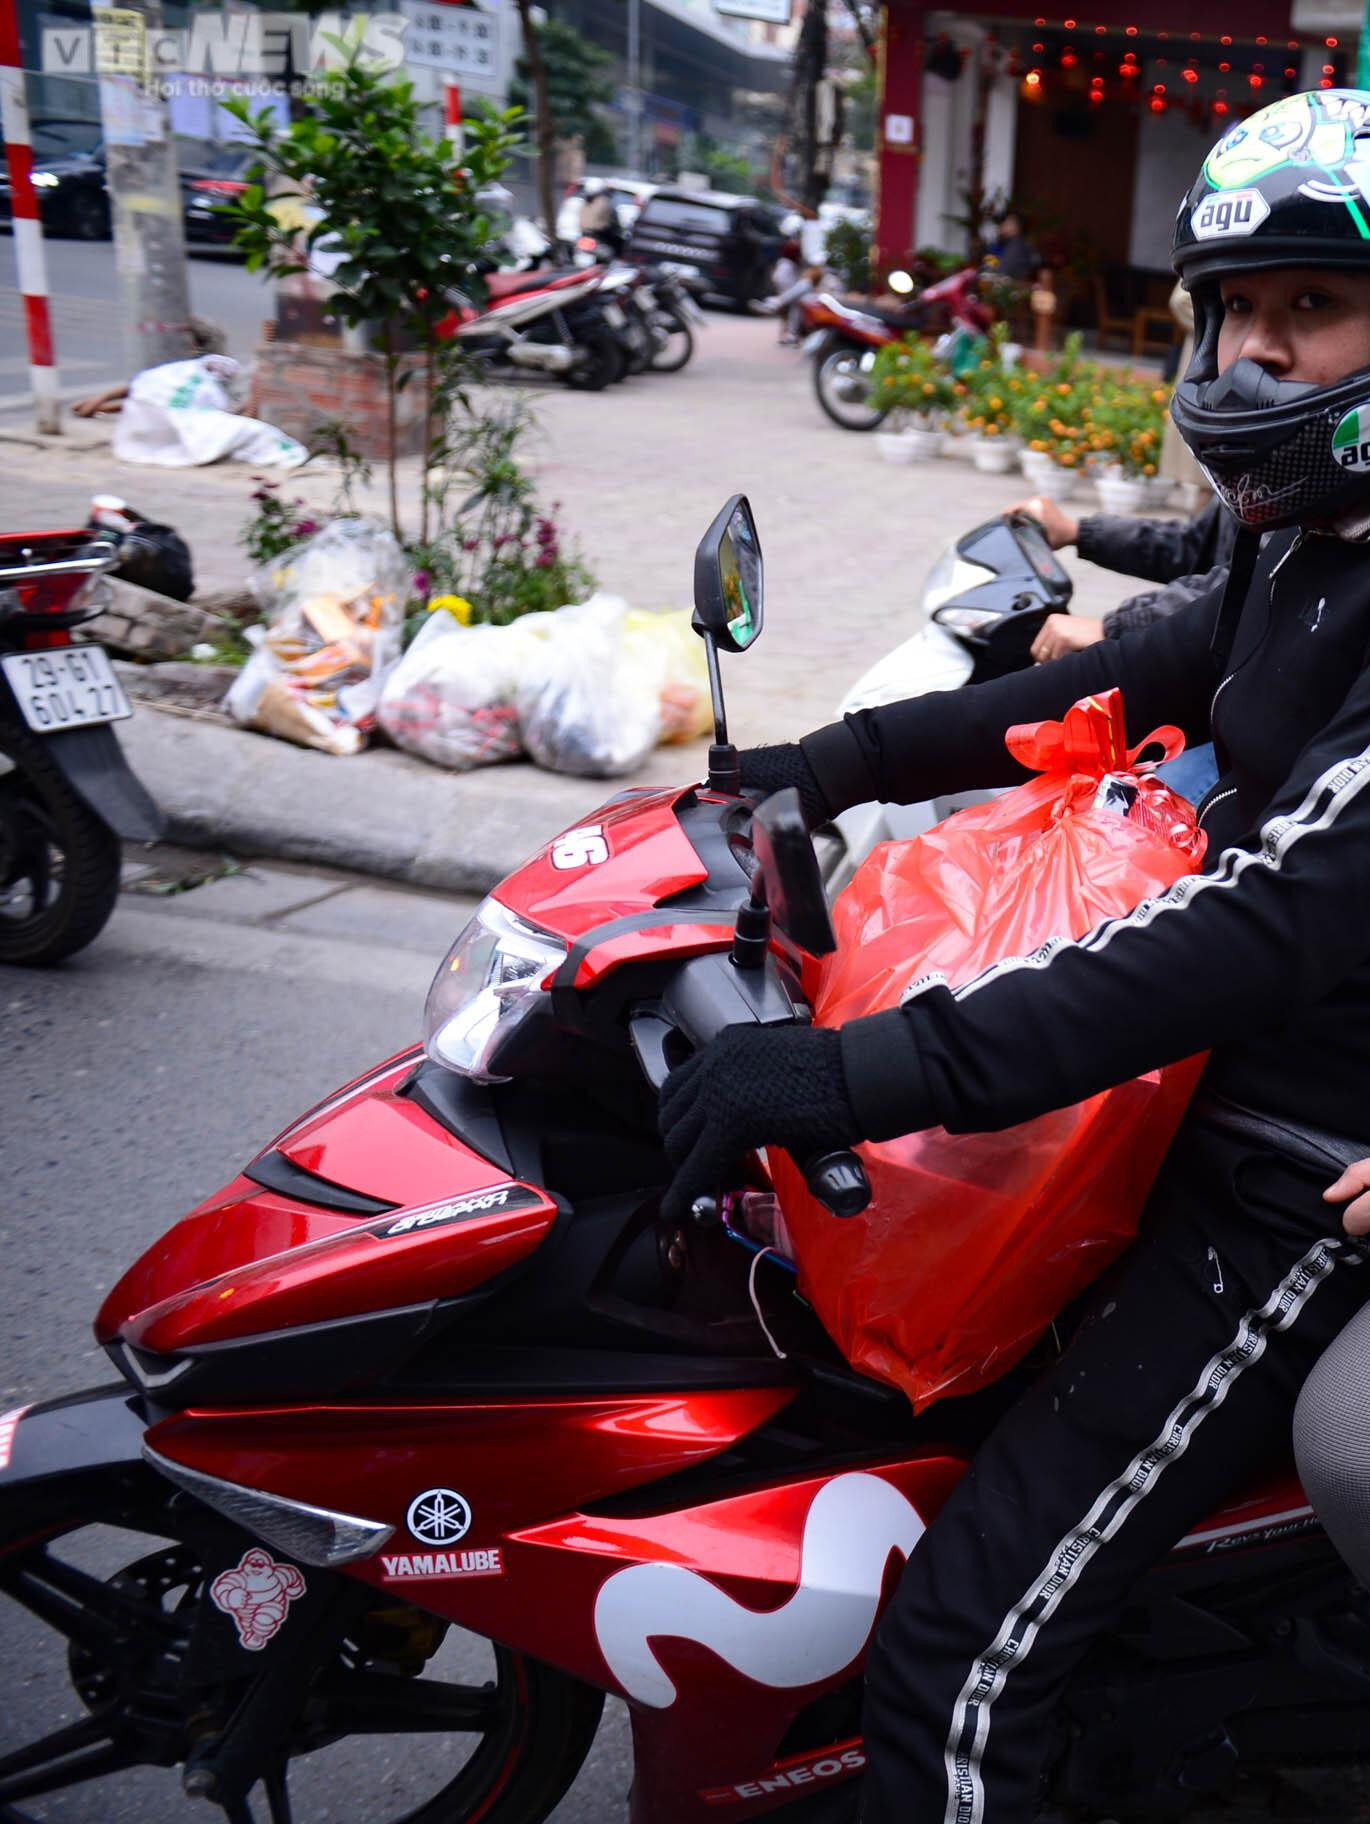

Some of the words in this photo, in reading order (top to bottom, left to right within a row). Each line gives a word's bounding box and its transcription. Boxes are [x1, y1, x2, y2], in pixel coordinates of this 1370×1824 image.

[1278, 1288, 1298, 1314] DIOR
[1207, 1362, 1228, 1391] DIOR
[1129, 1467, 1149, 1492] DIOR
[382, 1549, 501, 1577] YAMALUBE
[1039, 1575, 1064, 1600] DIOR
[967, 1682, 993, 1707] DIOR
[733, 1749, 866, 1798] ENEOS
